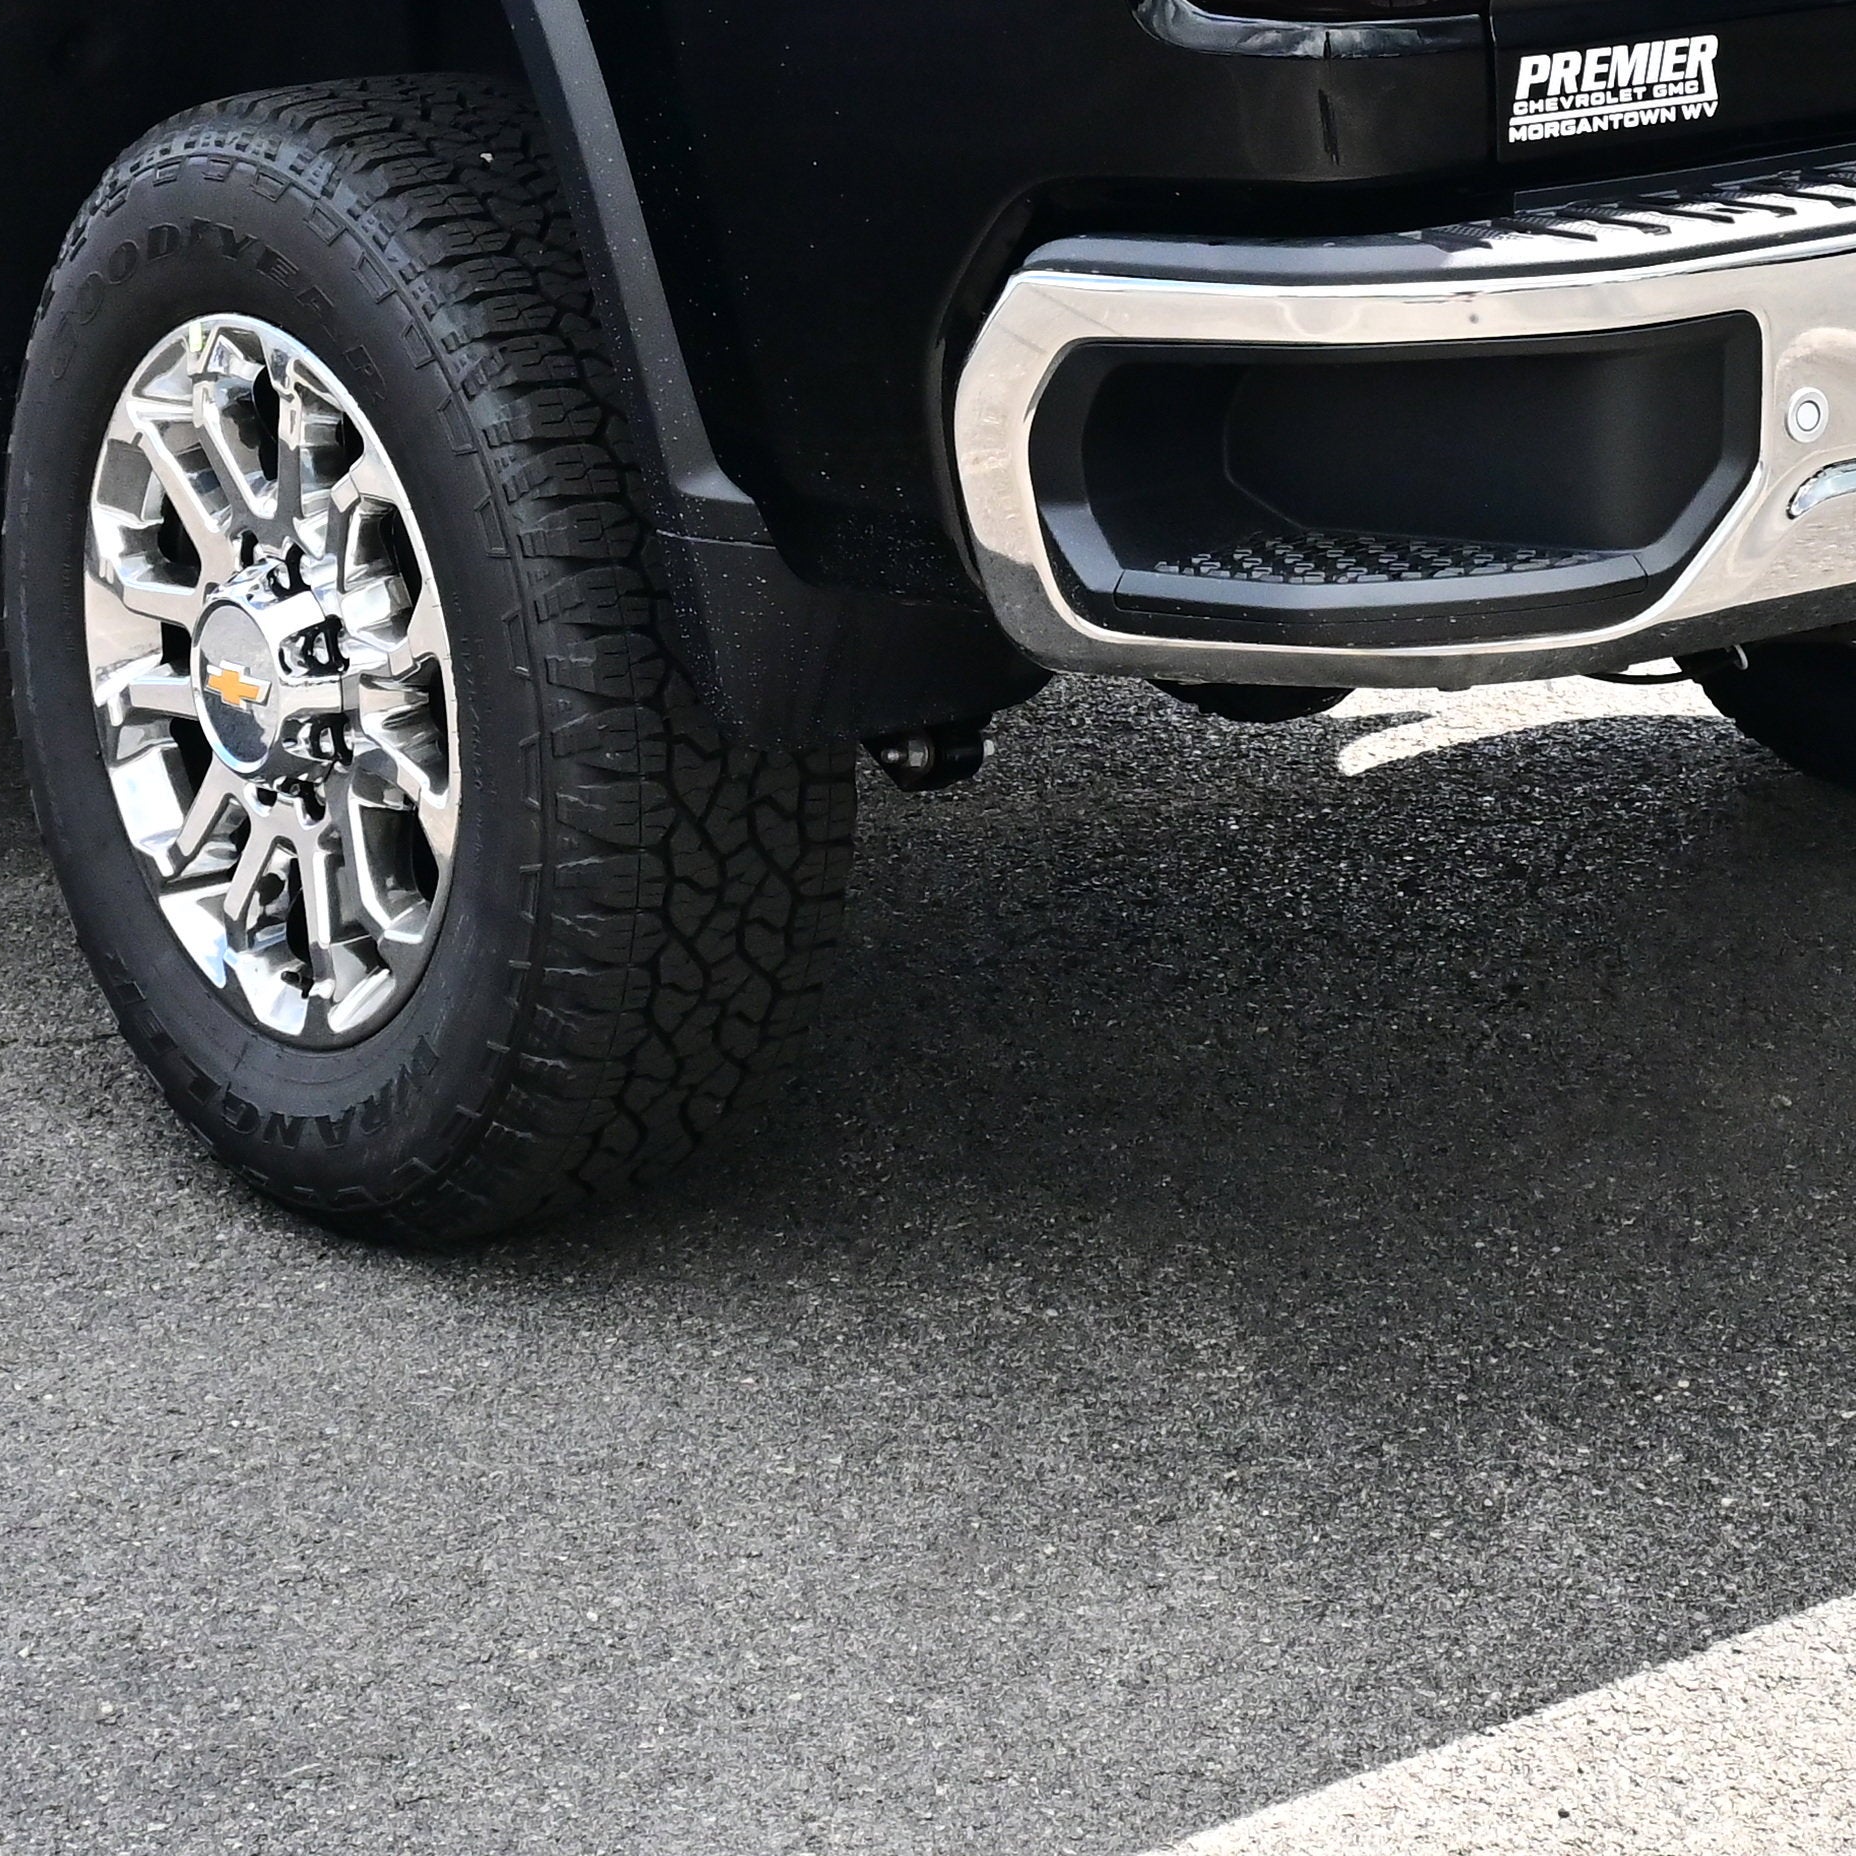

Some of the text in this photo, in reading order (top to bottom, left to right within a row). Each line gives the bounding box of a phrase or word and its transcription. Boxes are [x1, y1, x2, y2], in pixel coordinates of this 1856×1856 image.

[1515, 34, 1719, 101] PREMIER
[1512, 79, 1699, 116] CHEVROLET GMC
[1508, 101, 1719, 144] MORGANTOWN WV
